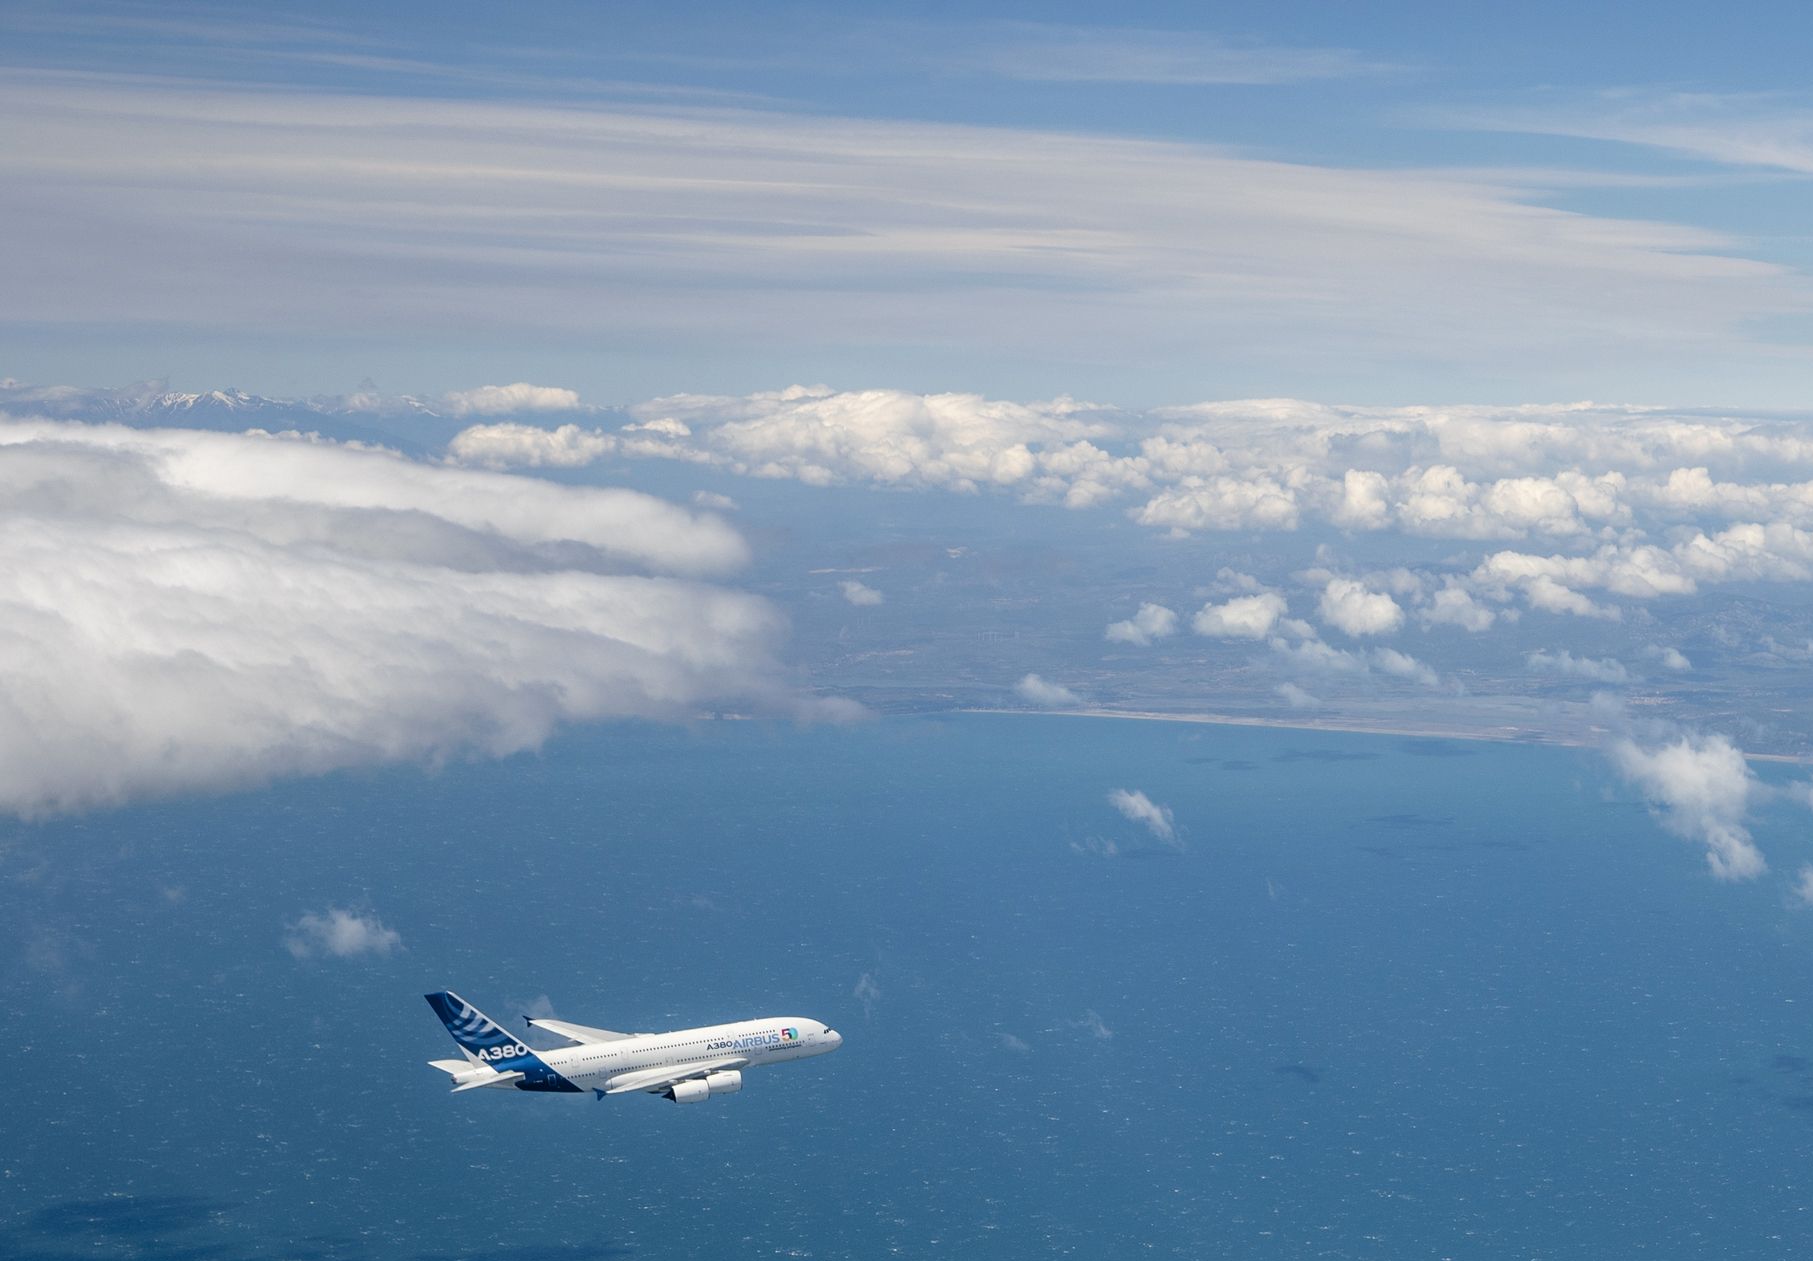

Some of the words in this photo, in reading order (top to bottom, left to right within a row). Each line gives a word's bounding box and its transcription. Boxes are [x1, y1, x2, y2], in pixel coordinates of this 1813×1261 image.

[706, 1041, 733, 1051] A380
[732, 1033, 780, 1050] AIRBUS
[478, 1044, 528, 1061] A380
